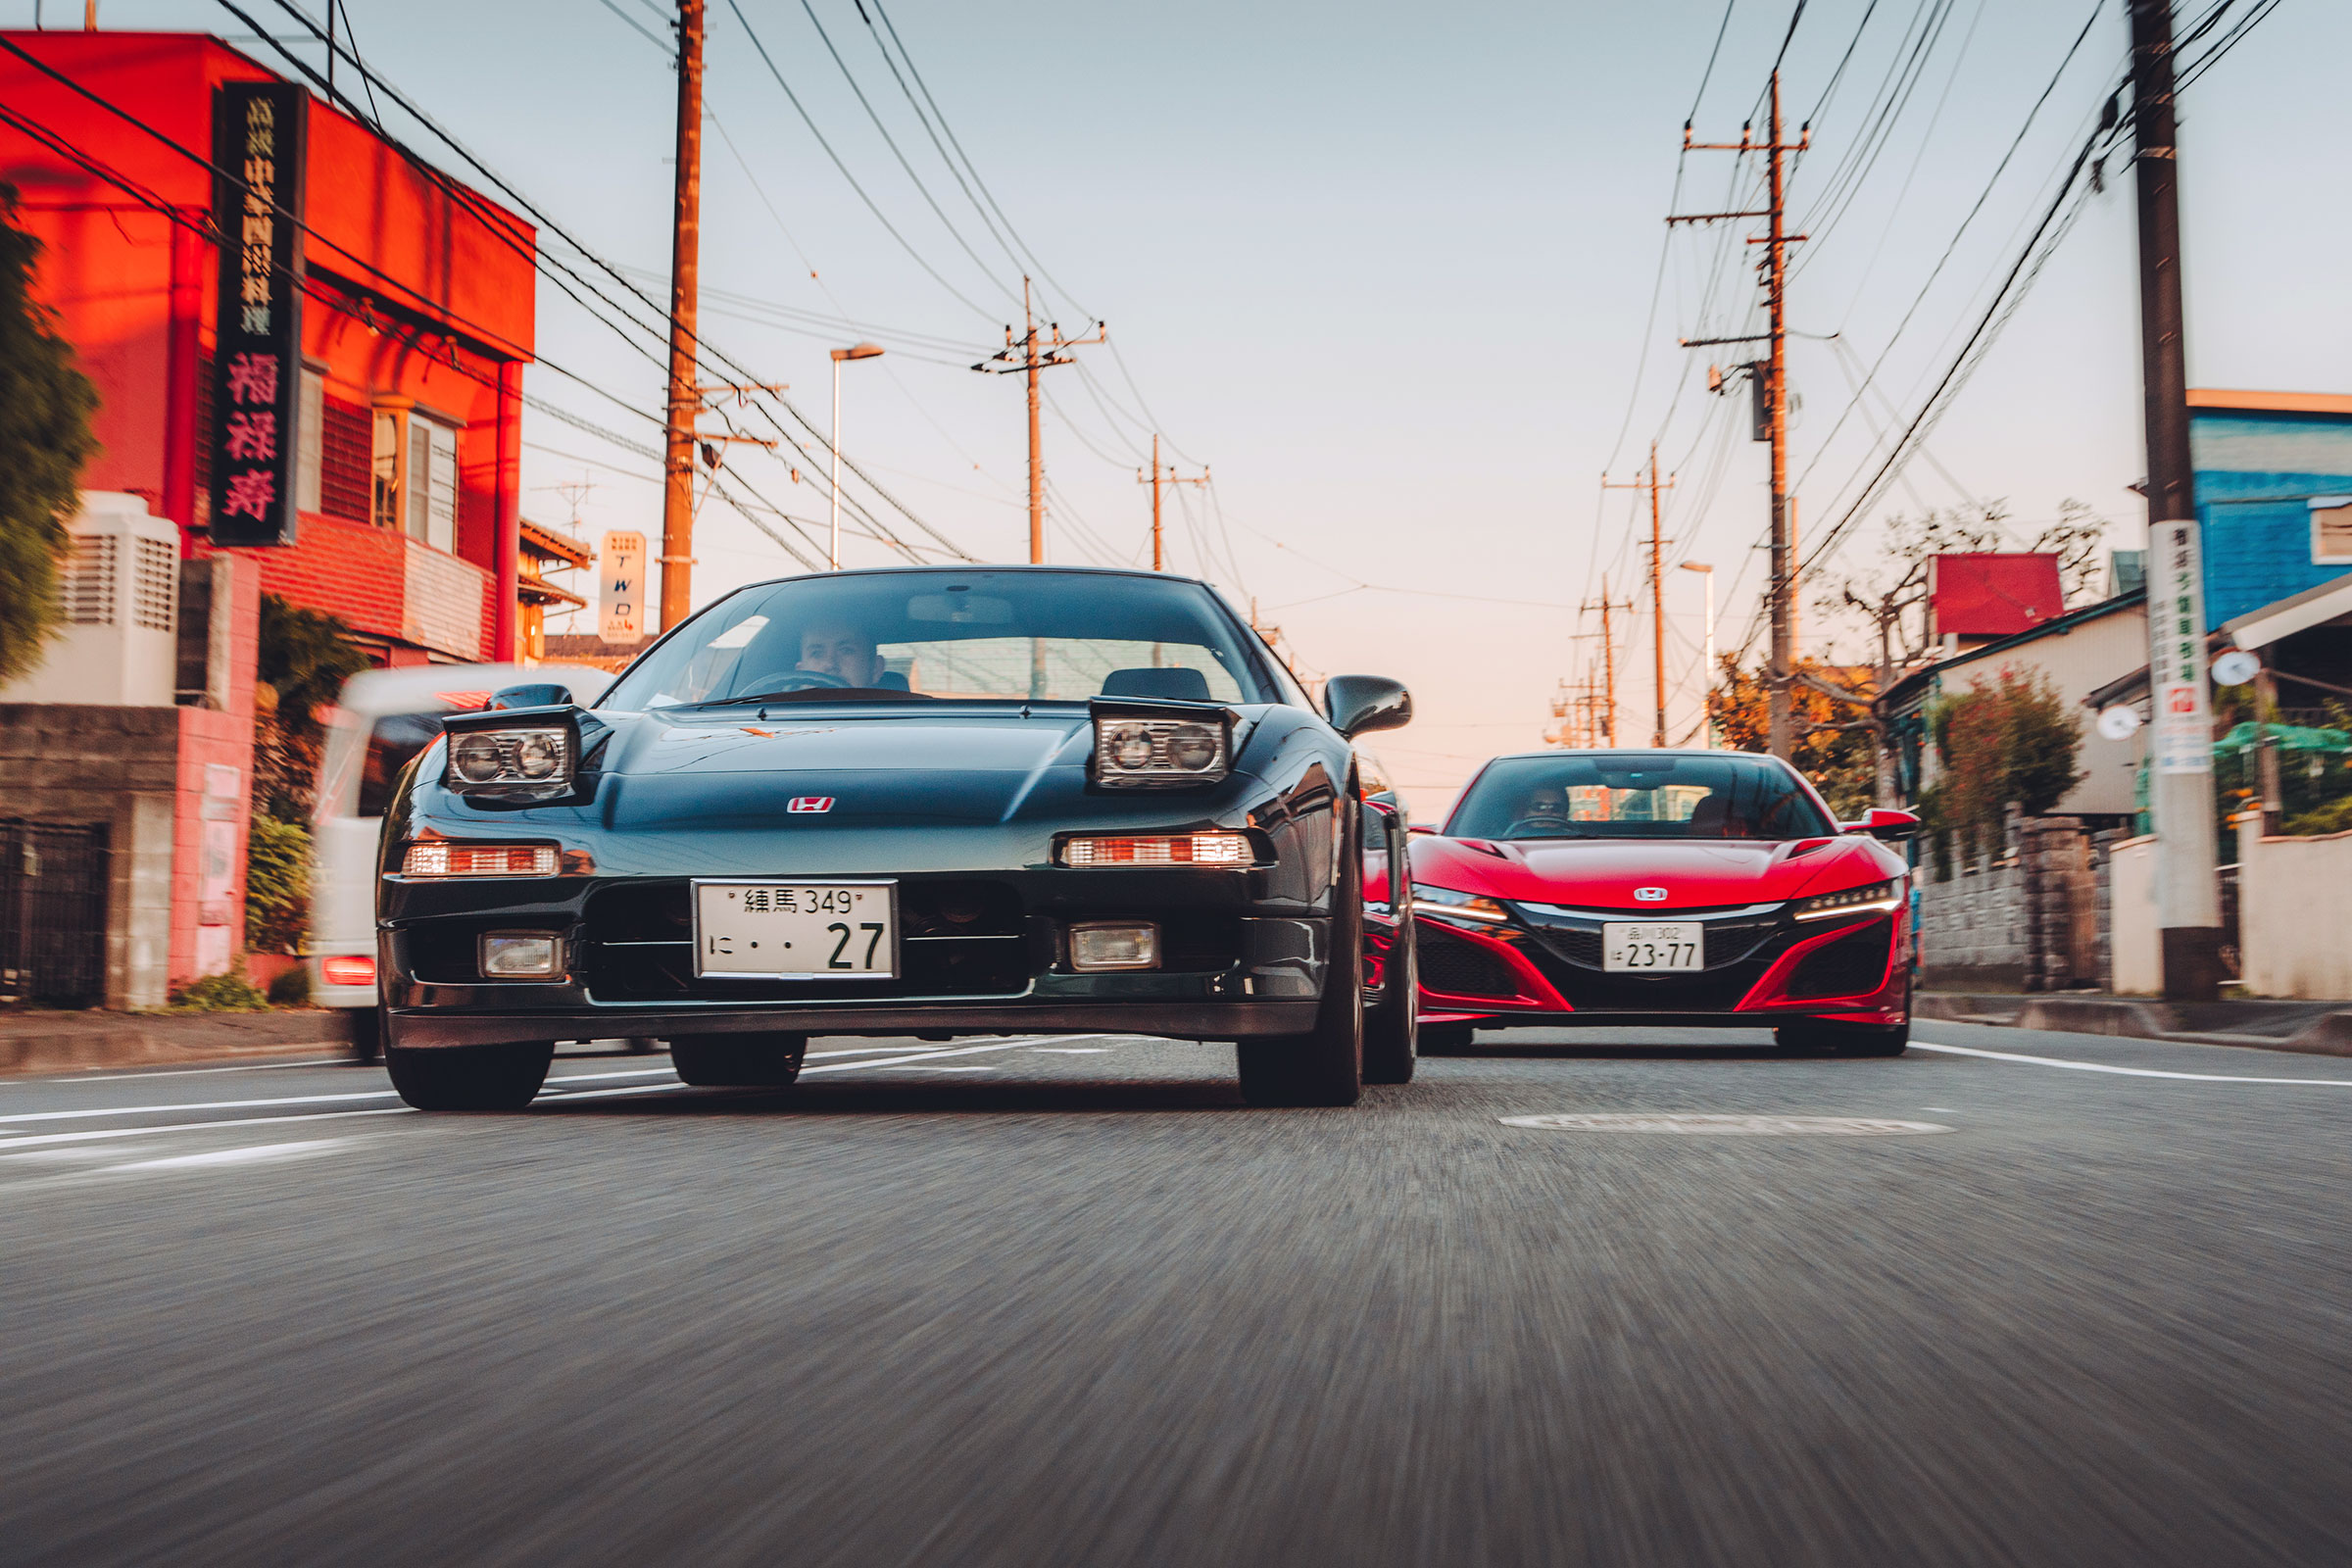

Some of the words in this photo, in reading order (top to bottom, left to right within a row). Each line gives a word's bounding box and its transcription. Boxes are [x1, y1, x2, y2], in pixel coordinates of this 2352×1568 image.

[744, 889, 797, 913] 練馬
[805, 890, 852, 913] 349
[710, 935, 733, 955] に
[1628, 944, 1695, 967] 23-77
